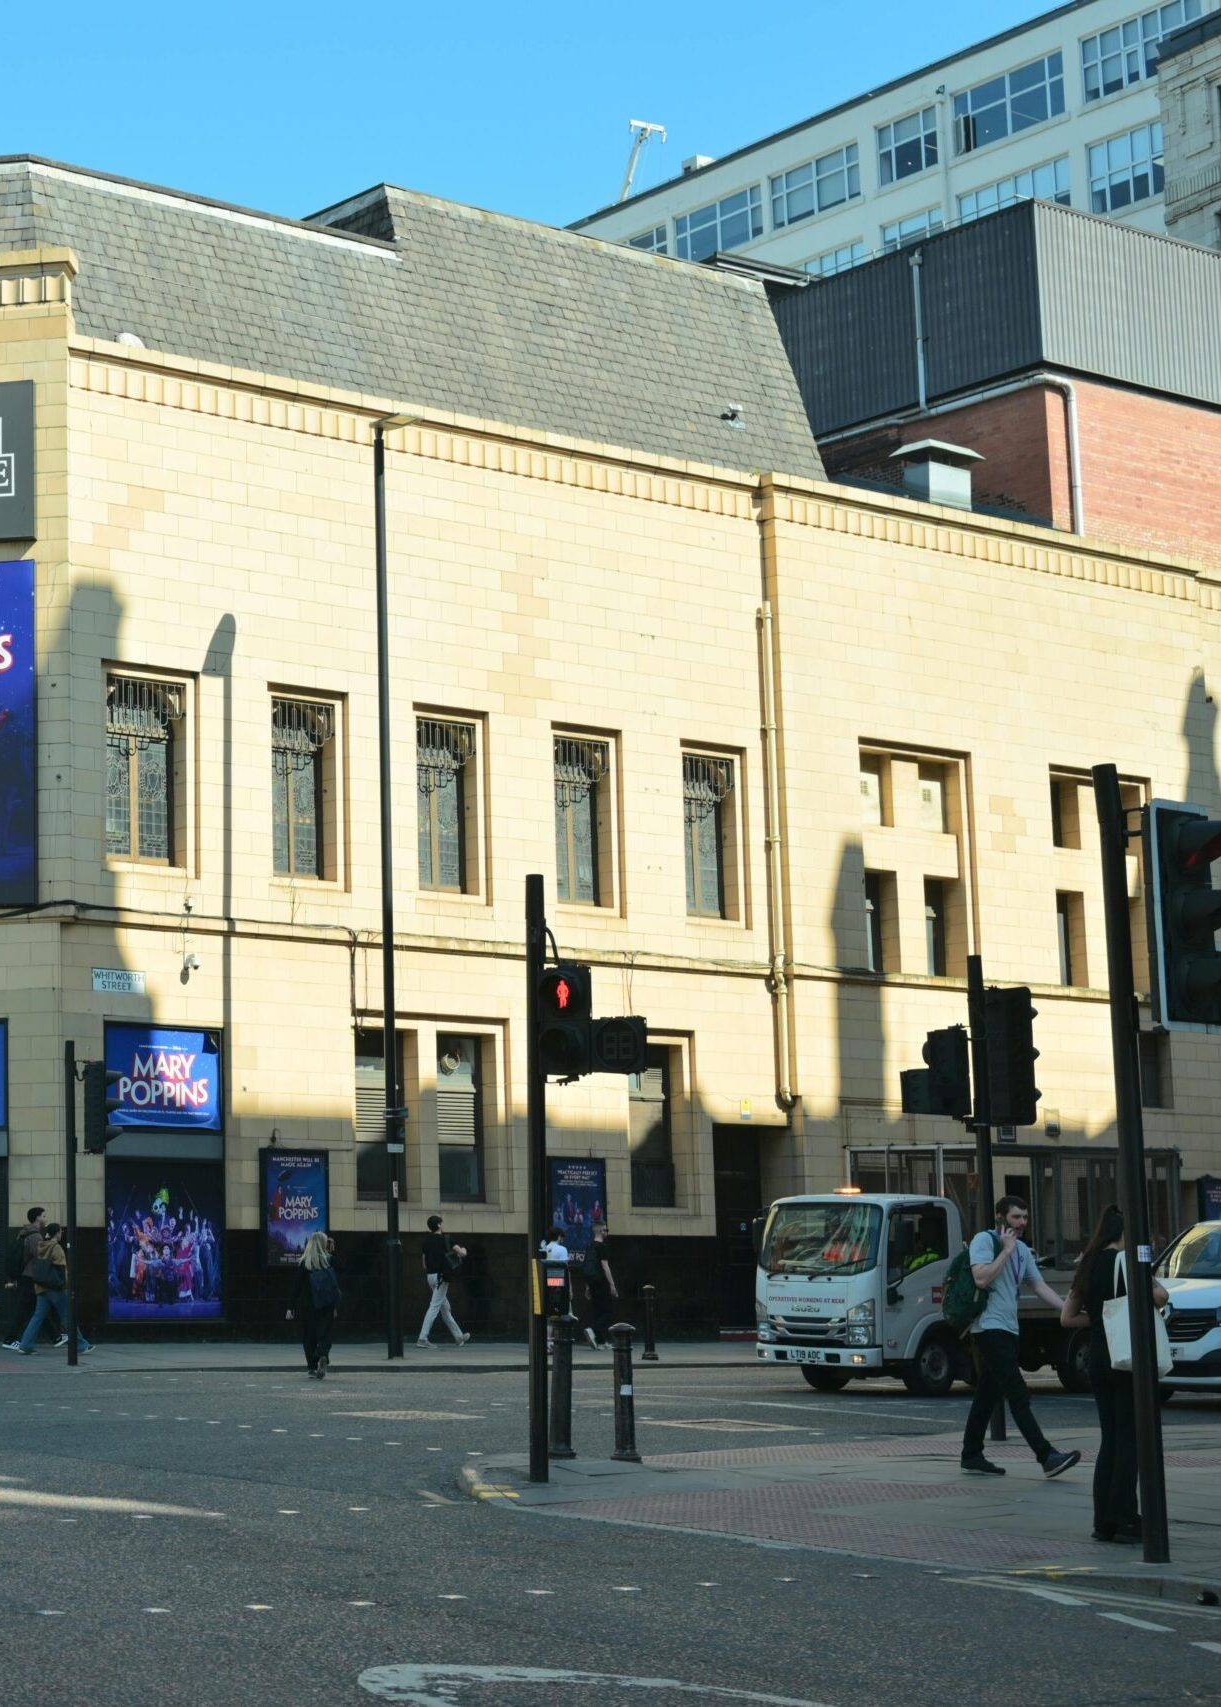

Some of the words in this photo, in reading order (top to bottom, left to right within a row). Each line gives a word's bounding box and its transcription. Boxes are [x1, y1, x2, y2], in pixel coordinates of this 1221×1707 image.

[94, 970, 145, 983] WHITWORTH
[101, 981, 132, 991] STREET
[133, 1051, 196, 1080] MARY
[119, 1077, 209, 1108] POPPINS
[285, 1195, 313, 1208] MARY
[278, 1206, 319, 1220] POPPINS
